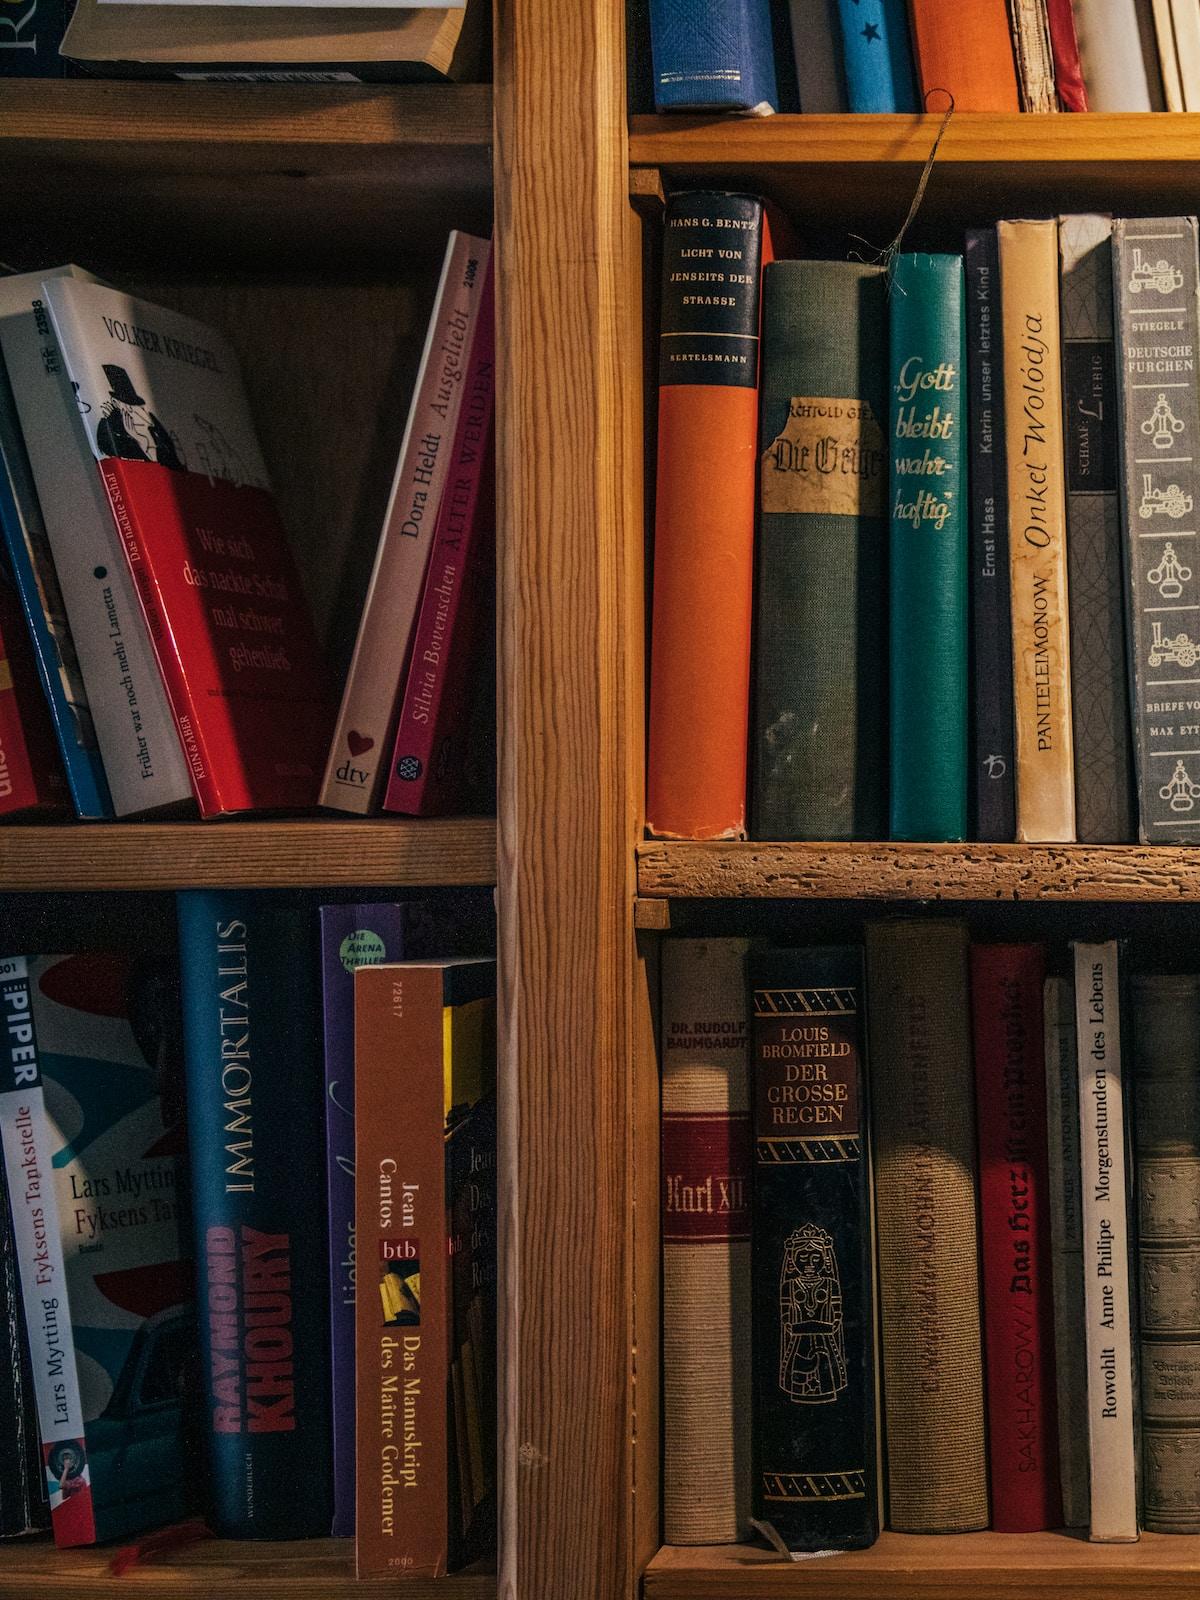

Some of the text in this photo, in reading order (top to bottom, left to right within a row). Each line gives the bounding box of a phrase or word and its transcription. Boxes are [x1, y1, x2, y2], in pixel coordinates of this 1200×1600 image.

[669, 218, 757, 231] HANS G. BENTZ
[680, 249, 742, 260] LICHT VON
[669, 272, 753, 284] JENSEITS DER
[31, 299, 51, 336] 23588
[682, 295, 736, 307] STRASSE
[1131, 321, 1184, 332] STIEGELE
[102, 316, 223, 374] VOLKER KRIEGEL
[669, 353, 747, 364] BERTELSMANN
[1127, 345, 1193, 359] DEUTSCHE
[1127, 359, 1194, 373] FURCHEN
[402, 309, 469, 539] Dora Heldt Ausgeliebt
[895, 407, 954, 440] bleibt
[978, 265, 995, 577] Ernst Hass Katrin unser letztes Kind
[772, 437, 810, 473] Die
[894, 449, 953, 475] wahr-
[117, 504, 140, 562] Das nackte
[413, 360, 493, 724] Silvia Bovenschen ÄLTER WERDEN
[1018, 312, 1052, 752] PANTELEIMONOW Onkel Wolódja
[183, 560, 209, 587] das
[212, 606, 239, 629] mal
[102, 586, 154, 779] Früher war noch mehr Lametta
[1146, 701, 1186, 713] BRIEFE
[1149, 726, 1174, 736] MAX
[336, 760, 371, 784] dtv
[347, 943, 382, 953] ARENA
[3, 990, 37, 1086] PIPER
[671, 1021, 745, 1035] DR. RUDOLF
[781, 1027, 829, 1042] LOUIS
[216, 919, 255, 1193] IMMORTALIS
[762, 1042, 850, 1059] BROMFIELD
[785, 1063, 828, 1082] DER
[767, 1083, 848, 1104] GROSSE
[772, 1104, 845, 1124] REGEN
[69, 1175, 111, 1199] Lars
[379, 1158, 398, 1229] Cantos
[666, 1174, 714, 1215] Karl
[1007, 1168, 1030, 1232] Herz
[1089, 962, 1117, 1419] Rowohlt Anne Philipe Morgenstunden des Lebens
[402, 1182, 420, 1227] Jean
[74, 1205, 148, 1239] Fyksens
[22, 1105, 69, 1426] Lars Mytting Fyksens Tankstelle
[383, 1240, 417, 1259] btb
[1009, 1239, 1032, 1296] Das
[206, 1225, 241, 1433] RAYMOND
[241, 1224, 296, 1433] KHOURY
[1013, 1317, 1037, 1473] SAKHAROW
[402, 1336, 423, 1489] Das Manuskript
[381, 1336, 401, 1538] des Godemer
